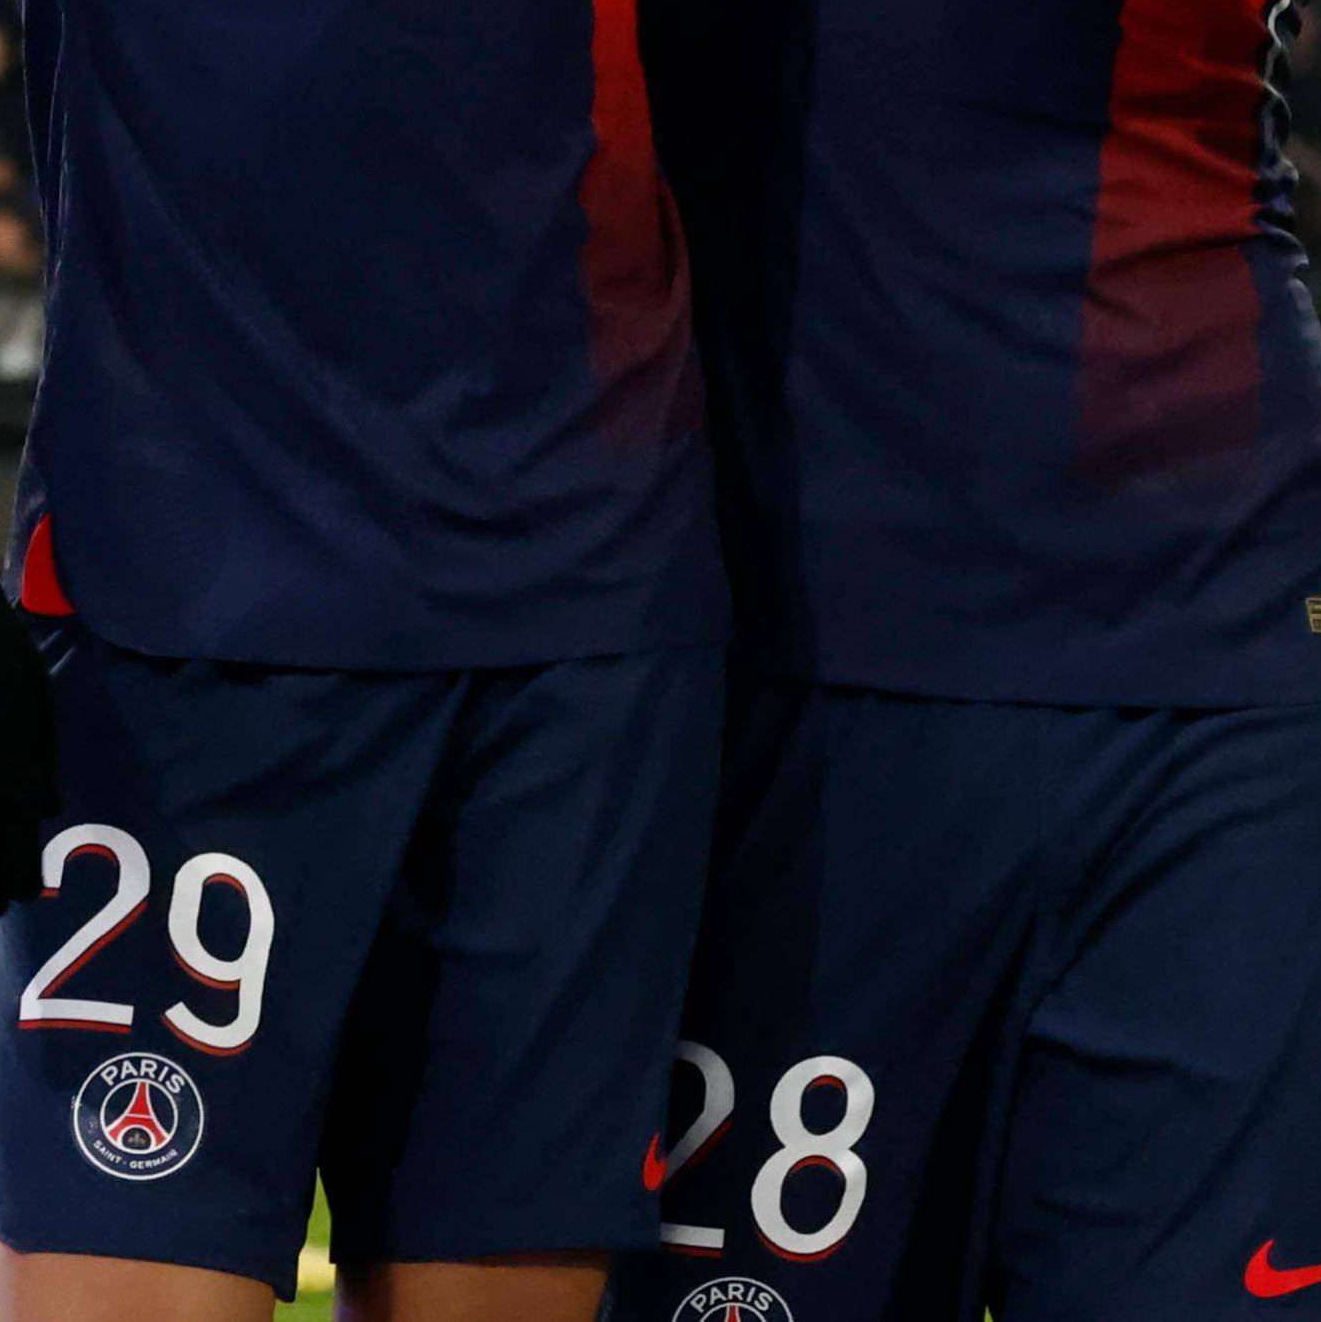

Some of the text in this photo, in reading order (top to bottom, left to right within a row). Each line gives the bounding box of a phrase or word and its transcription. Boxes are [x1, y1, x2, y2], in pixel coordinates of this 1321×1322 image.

[18, 823, 275, 1057] 29
[100, 1059, 186, 1094] PARIS
[93, 1139, 178, 1169] SAINT GERMAIN
[661, 1040, 875, 1263] 28
[689, 1282, 774, 1314] PARIS
